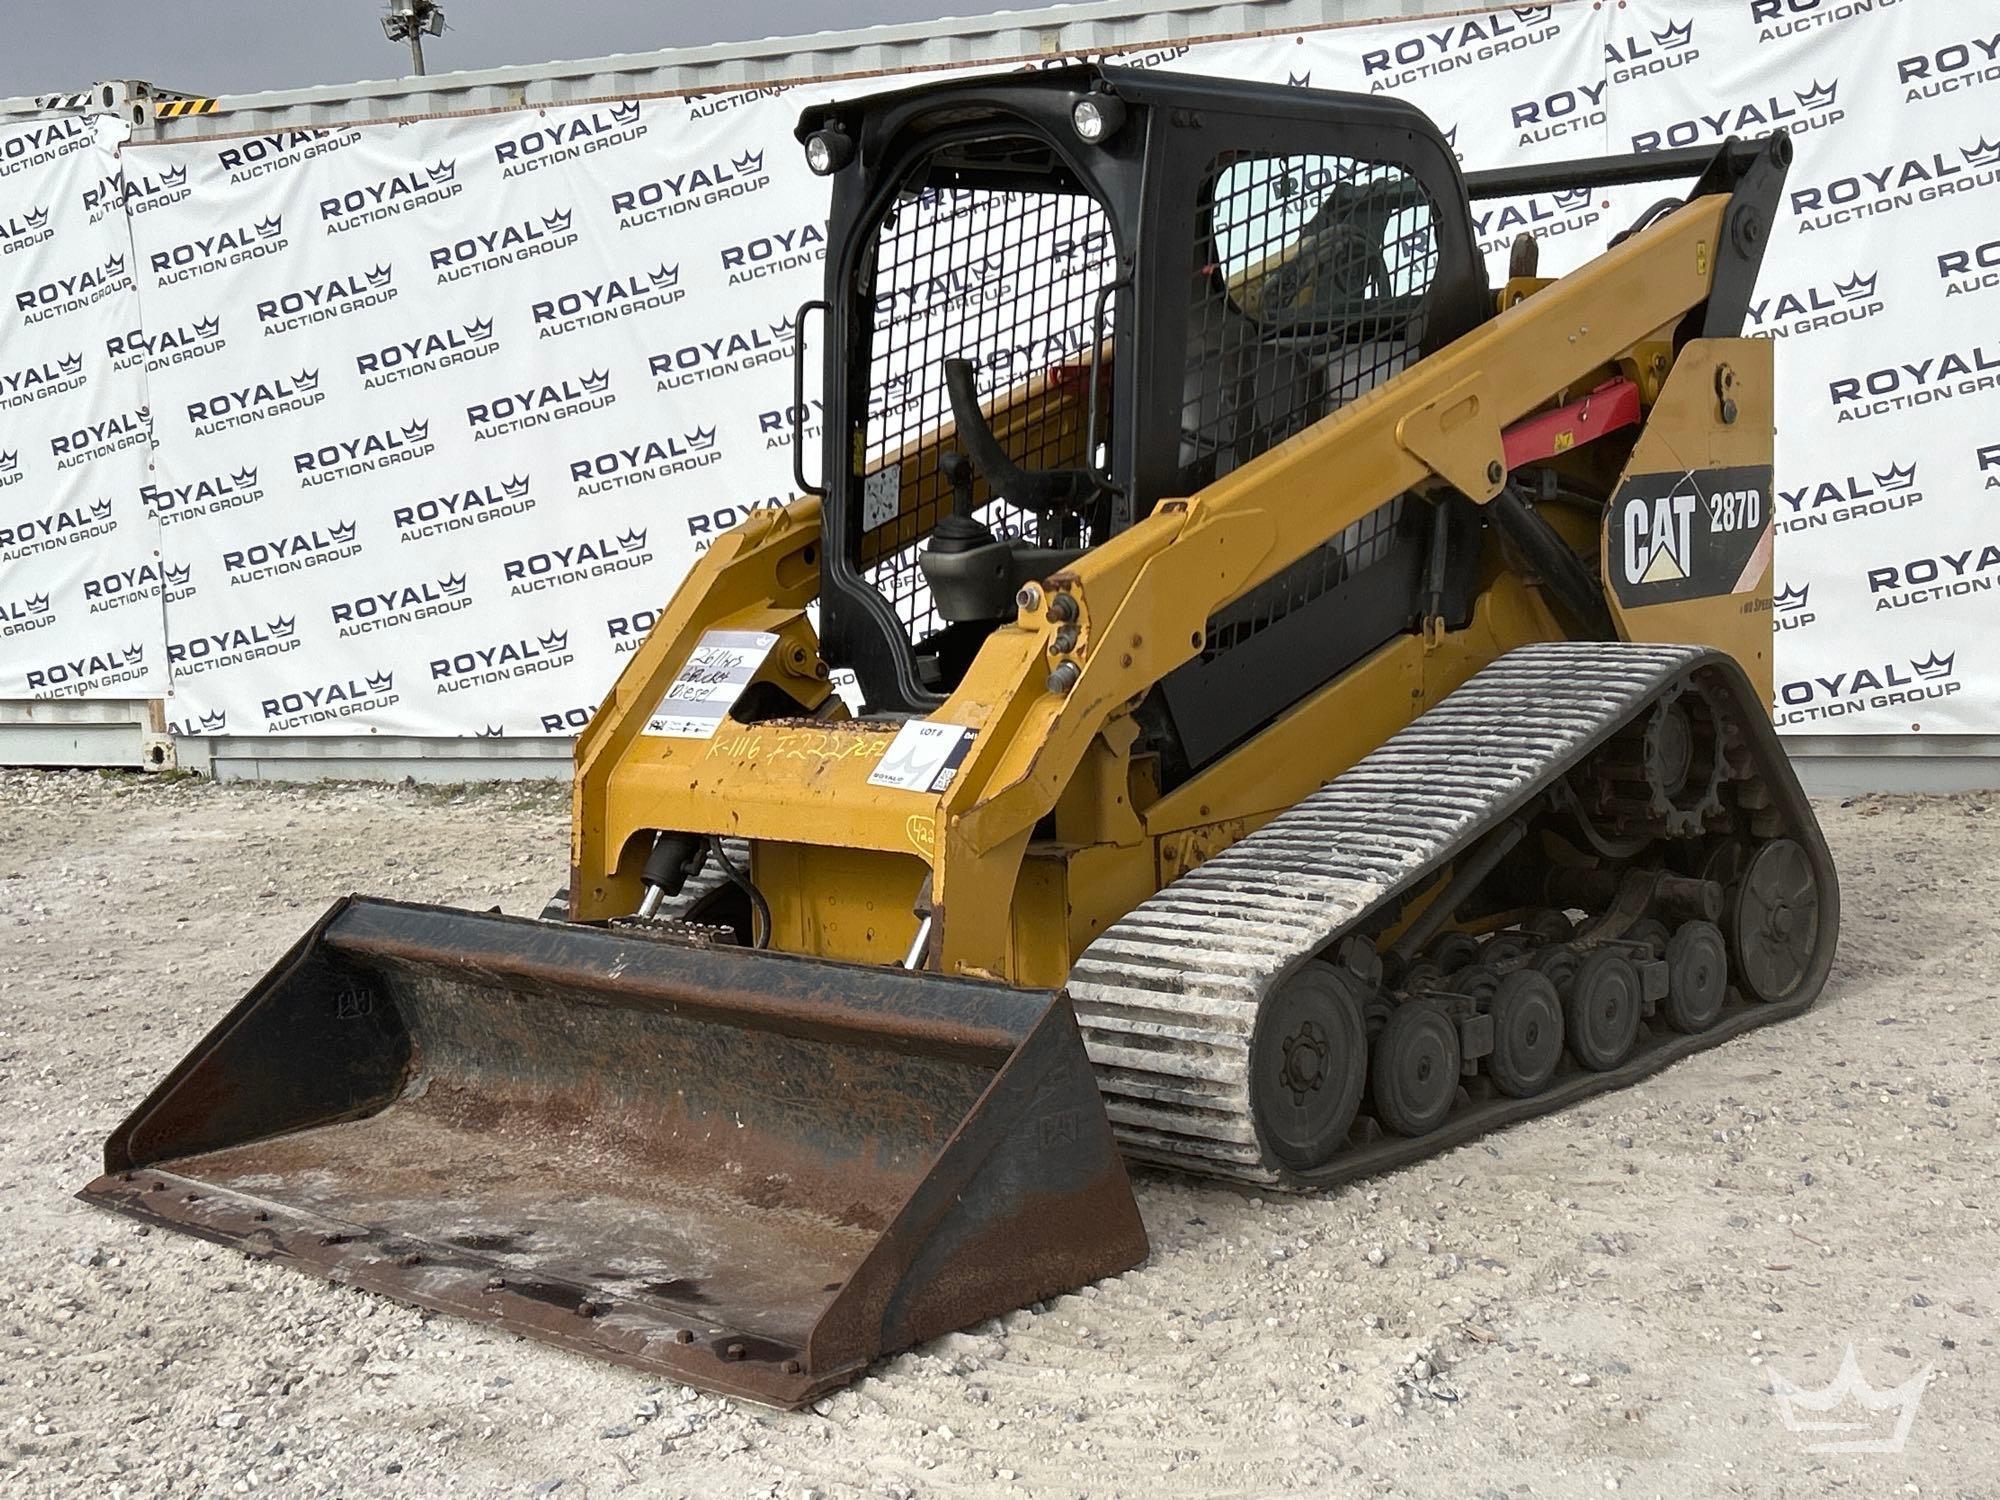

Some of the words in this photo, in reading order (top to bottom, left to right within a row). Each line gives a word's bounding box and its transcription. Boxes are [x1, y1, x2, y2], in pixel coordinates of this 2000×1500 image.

[1758, 0, 1873, 43] AUCTION
[1362, 14, 1515, 76] ROYAL
[1370, 52, 1473, 95] AUCTION
[1477, 25, 1560, 60] GROUP
[1613, 49, 1700, 84] GROUP
[690, 87, 774, 121] AUCTION
[1631, 97, 1796, 153] ROYAL
[0, 119, 82, 162] OYAL
[231, 152, 301, 185] AUCTION
[304, 132, 361, 159] GROUP
[495, 114, 612, 164] ROYAL
[503, 146, 580, 179] AUCTION
[584, 125, 647, 153] GROUP
[136, 188, 192, 214] GROUP
[320, 172, 429, 220] ROYAL
[612, 164, 733, 214] ROYAL
[620, 197, 701, 230] AUCTION
[704, 176, 769, 204] GROUP
[1790, 154, 1961, 215] ROYAL
[327, 204, 400, 235] AUCTION
[403, 184, 462, 211] GROUP
[1798, 192, 1913, 234] AUCTION
[3, 229, 55, 255] GROUP
[150, 228, 255, 273] ROYAL
[430, 221, 544, 269] ROYAL
[437, 253, 513, 285] AUCTION
[516, 234, 578, 260] GROUP
[158, 258, 227, 288] AUCTION
[230, 239, 288, 265] GROUP
[728, 252, 812, 286] AUCTION
[16, 267, 106, 311] ROYAL
[24, 296, 89, 326] AUCTION
[91, 277, 132, 304] GROUP
[257, 276, 367, 322] ROYAL
[532, 276, 650, 324] ROYAL
[264, 307, 337, 336] AUCTION
[340, 288, 398, 314] GROUP
[540, 308, 618, 339] AUCTION
[621, 290, 685, 315] GROUP
[1794, 301, 1884, 336] GROUP
[173, 339, 226, 364] GROUP
[356, 330, 466, 375] ROYAL
[364, 360, 436, 390] AUCTION
[439, 342, 499, 367] GROUP
[648, 329, 771, 376] ROYAL
[0, 364, 60, 396] YAL
[37, 376, 87, 399] GROUP
[657, 361, 738, 392] AUCTION
[1829, 347, 2000, 405] ROYAL
[187, 380, 293, 423] ROYAL
[195, 409, 264, 438] AUCTION
[268, 393, 325, 416] GROUP
[467, 381, 581, 426] ROYAL
[475, 412, 550, 441] AUCTION
[554, 395, 615, 419] GROUP
[1837, 385, 1953, 423] AUCTION
[51, 414, 137, 456] ROYAL
[294, 431, 403, 473] ROYAL
[57, 443, 116, 471] AUCTION
[302, 460, 375, 488] AUCTION
[378, 444, 435, 467] GROUP
[570, 438, 687, 482] ROYAL
[578, 468, 655, 497] AUCTION
[659, 452, 721, 476] GROUP
[209, 490, 264, 513] GROUP
[393, 486, 503, 528] ROYAL
[401, 515, 474, 543] AUCTION
[477, 499, 535, 523] GROUP
[1833, 492, 1923, 522] GROUP
[0, 508, 92, 548] ROYAL
[3, 536, 67, 562] AUCTION
[70, 521, 117, 543] GROUP
[1624, 495, 1696, 585] CAT
[1710, 490, 1761, 533] 287D
[223, 531, 330, 571] ROYAL
[231, 560, 302, 586] AUCTION
[305, 544, 362, 567] GROUP
[504, 539, 619, 581] ROYAL
[511, 569, 588, 596] AUCTION
[591, 554, 653, 576] GROUP
[1876, 577, 1991, 611] AUCTION
[90, 589, 149, 614] AUCTION
[331, 583, 440, 624] ROYAL
[340, 612, 411, 638] AUCTION
[415, 598, 472, 619] GROUP
[3, 615, 56, 637] GROUP
[168, 625, 269, 664] ROYAL
[26, 653, 124, 689] ROYAL
[102, 666, 148, 686] GROUP
[175, 653, 243, 678] AUCTION
[245, 639, 301, 660] GROUP
[430, 640, 540, 680] ROYAL
[437, 669, 510, 694] AUCTION
[513, 654, 574, 676] GROUP
[261, 681, 367, 718] ROYAL
[1773, 664, 1912, 708] OYAL
[1870, 682, 1961, 708] GROUP
[269, 709, 338, 733] AUCTION
[339, 695, 399, 716] GROUP
[920, 727, 936, 737] LOT
